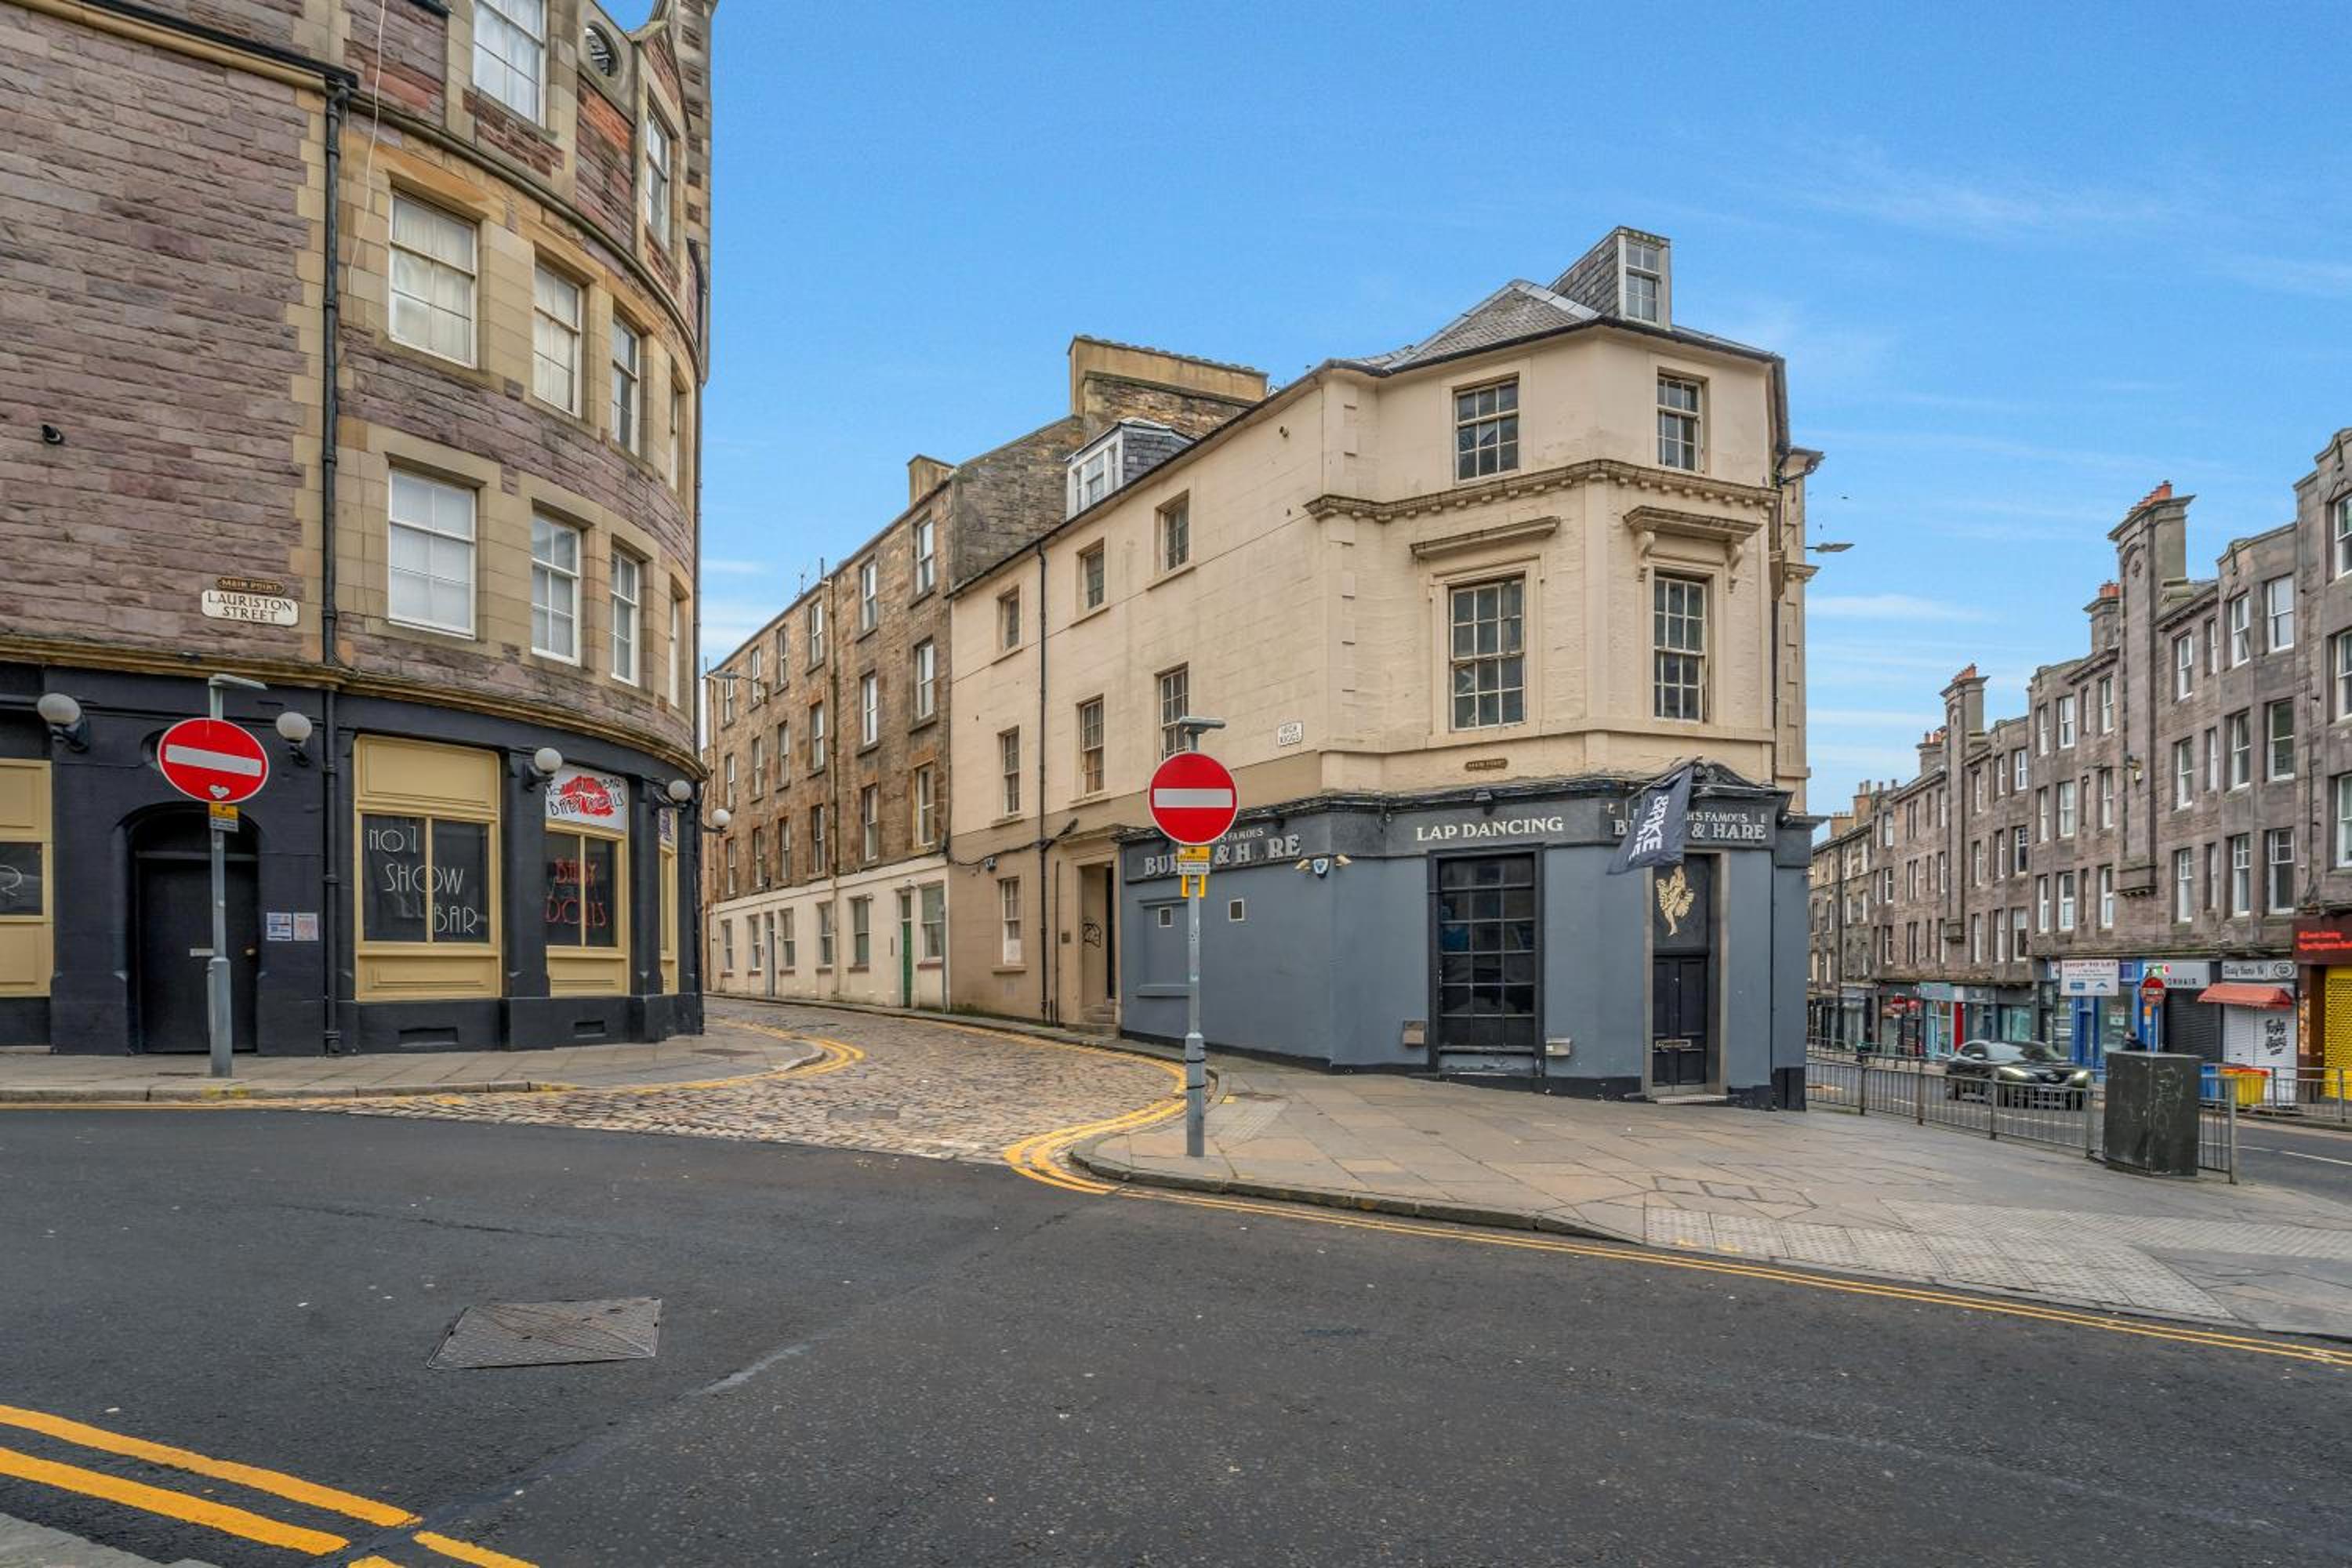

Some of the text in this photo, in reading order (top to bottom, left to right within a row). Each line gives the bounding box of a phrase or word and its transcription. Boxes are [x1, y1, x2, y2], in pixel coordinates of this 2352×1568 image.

[208, 592, 292, 612] LAURISTON
[223, 606, 278, 622] STREET
[1417, 816, 1564, 841] LAP DANCING
[1691, 822, 1766, 840] & HARE
[1215, 844, 1230, 865] &
[383, 863, 464, 895] SHOW
[434, 903, 477, 934] BAR
